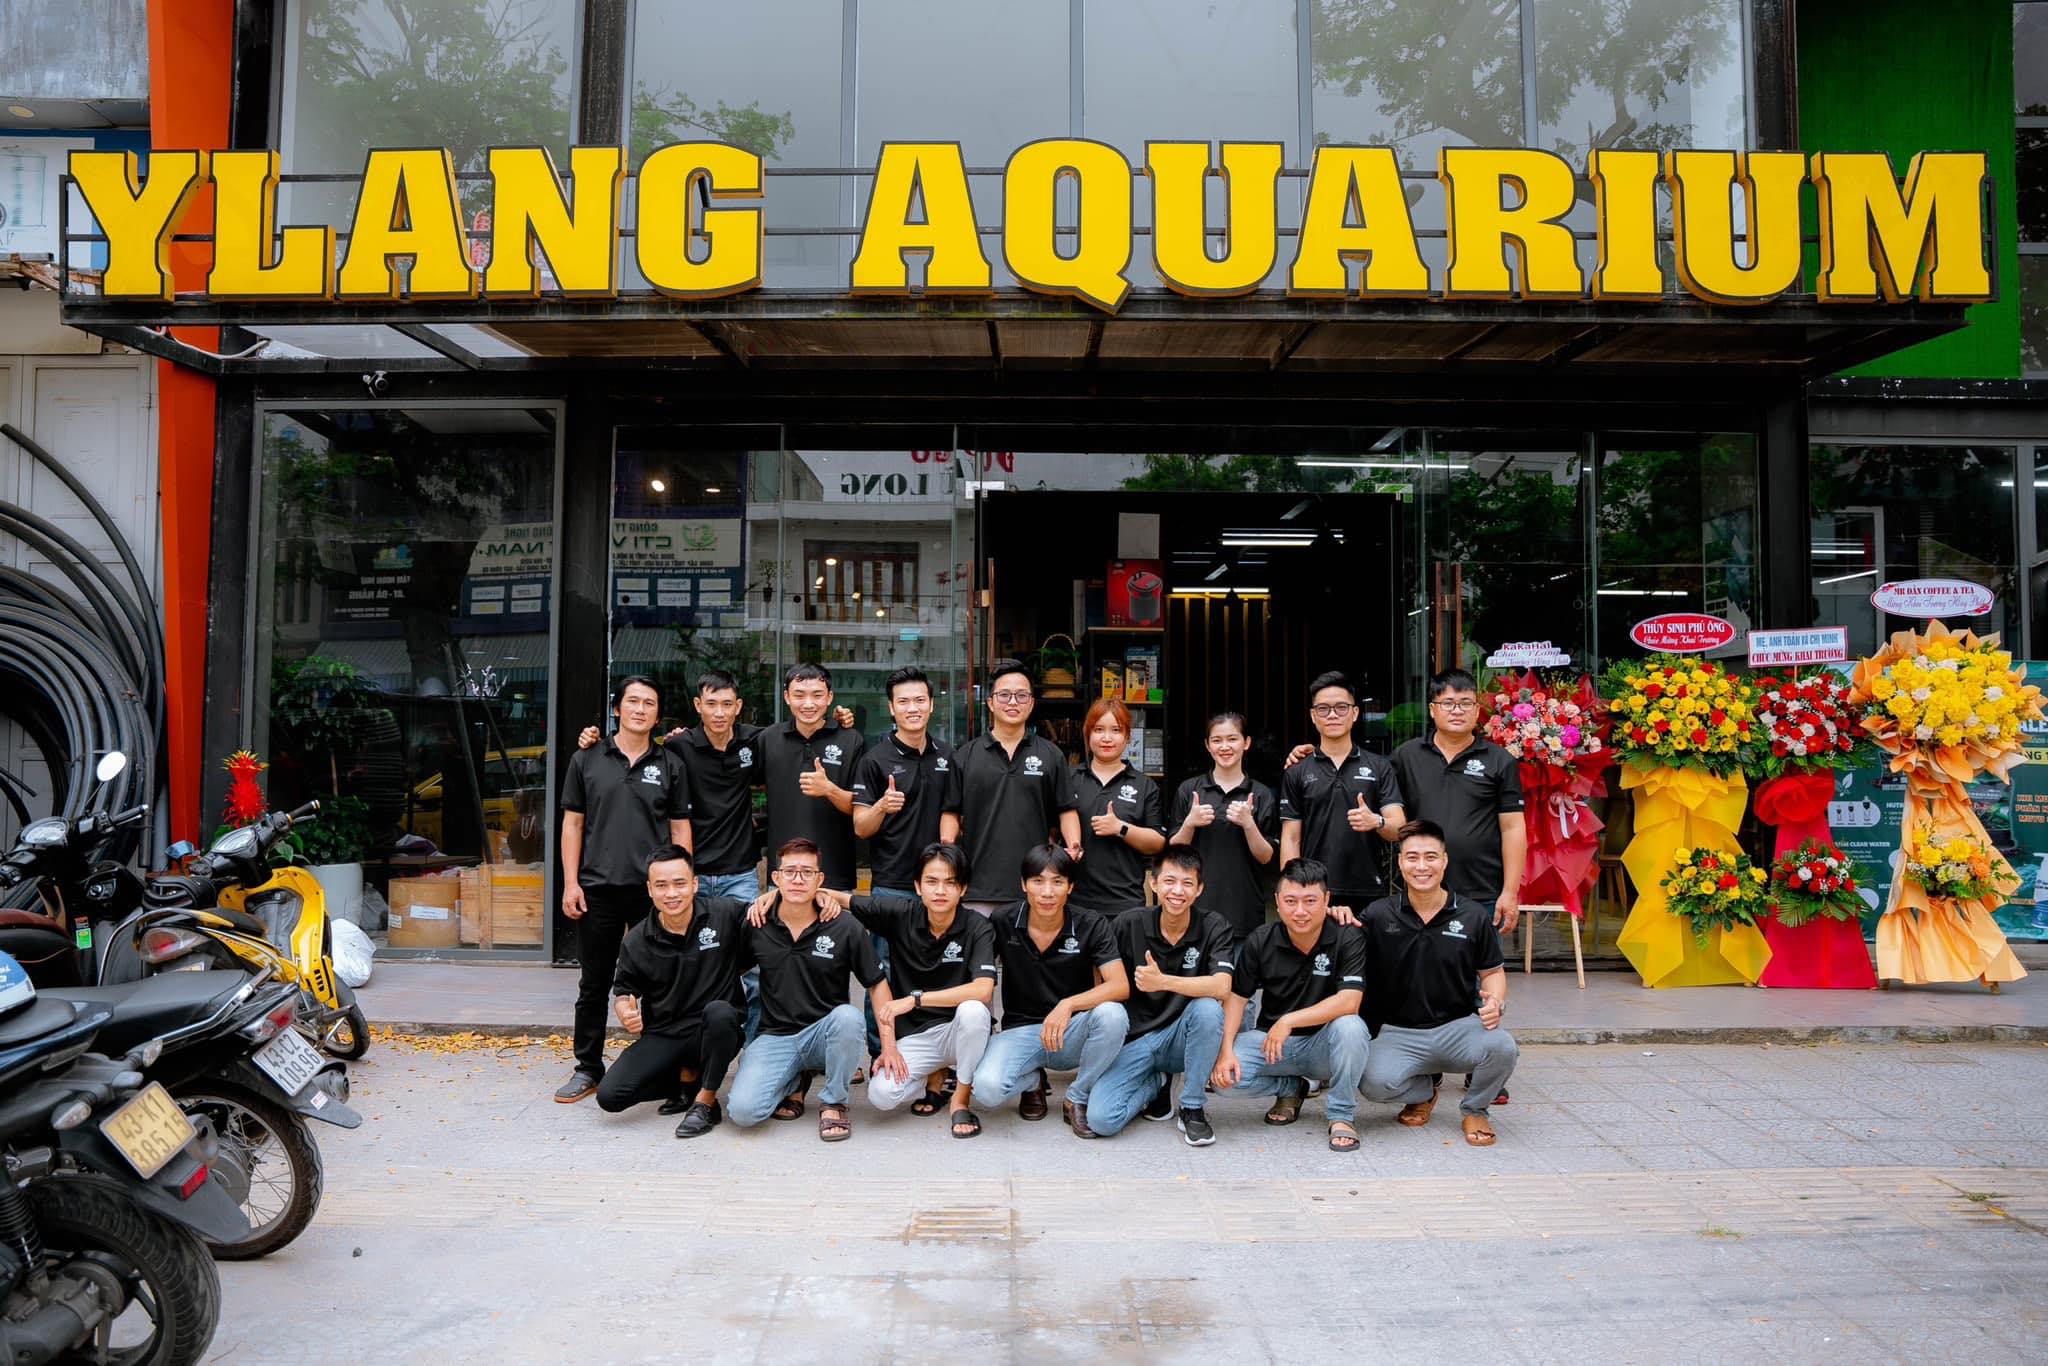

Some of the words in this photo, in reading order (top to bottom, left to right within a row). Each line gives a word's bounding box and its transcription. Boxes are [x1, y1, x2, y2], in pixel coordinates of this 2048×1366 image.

[67, 143, 762, 299] YLANG
[851, 139, 1991, 309] AQUARIUM
[1923, 586, 1951, 596] COFFEE
[1952, 586, 1959, 595] &
[1961, 586, 1974, 595] TEA
[1667, 623, 1686, 634] SINH
[1688, 620, 1705, 634] PHÚ
[1707, 620, 1725, 633] ÔNG
[277, 1047, 322, 1091] 109.96
